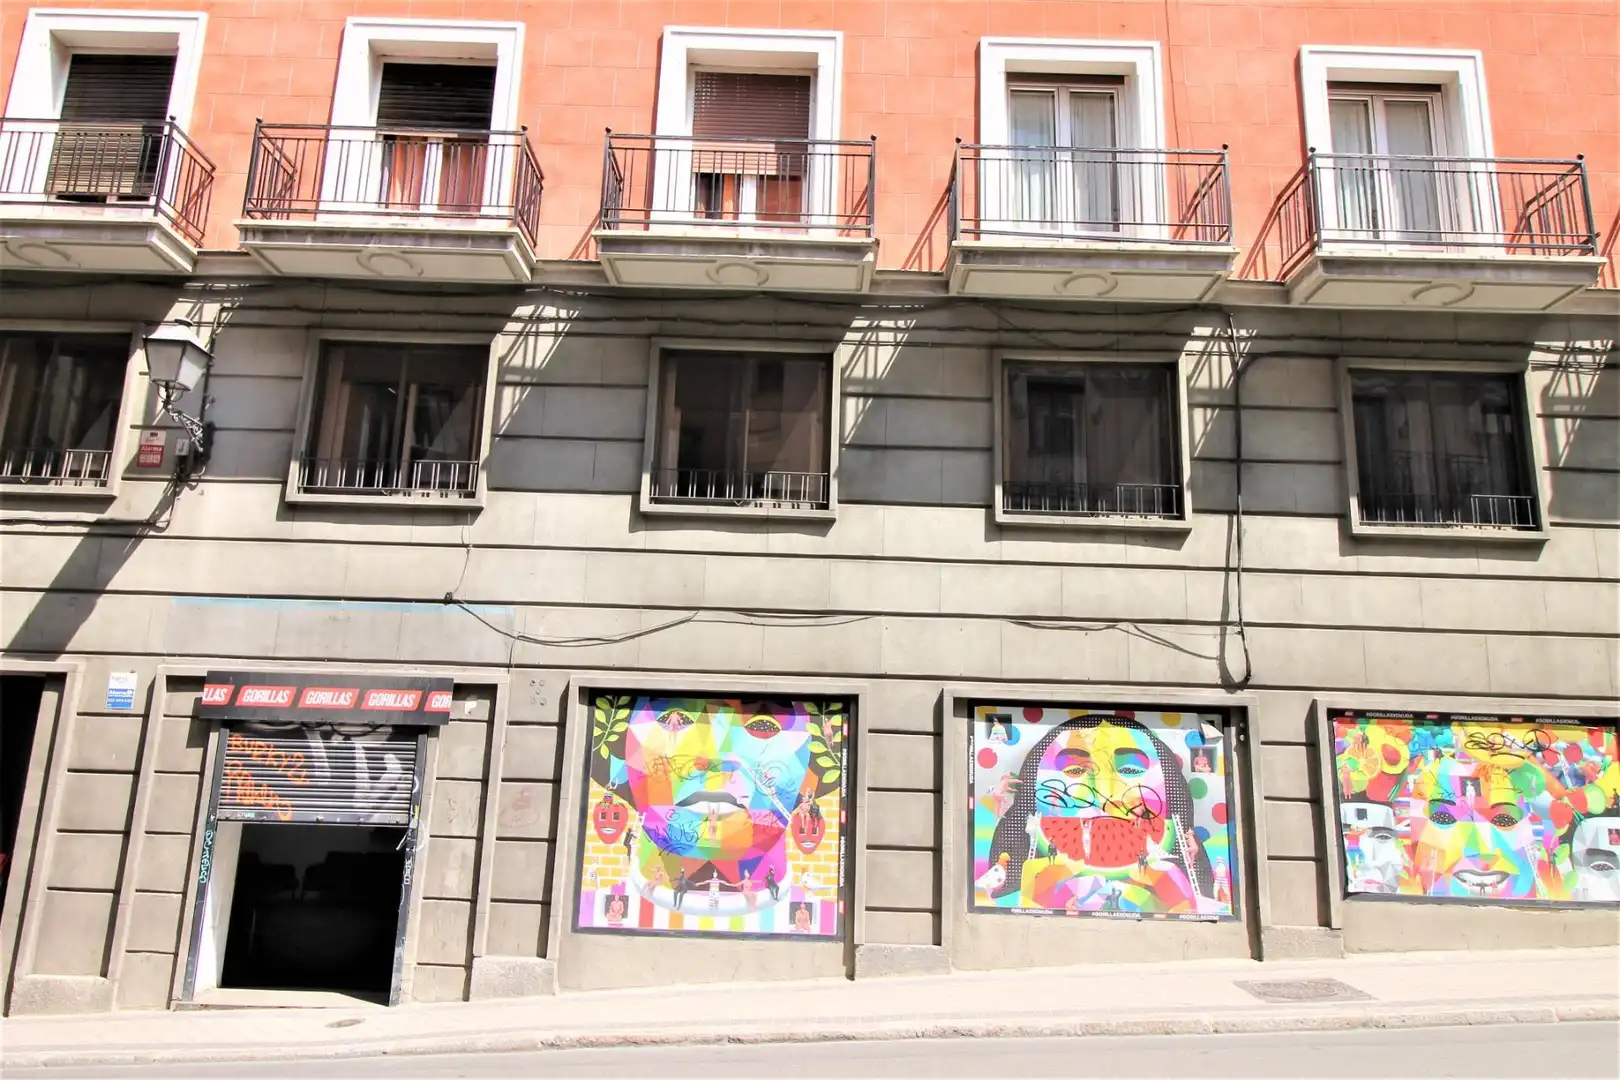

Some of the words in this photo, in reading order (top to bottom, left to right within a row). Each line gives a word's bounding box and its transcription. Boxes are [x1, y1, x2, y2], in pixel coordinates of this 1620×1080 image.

[242, 688, 290, 704] GORILLAS
[305, 690, 353, 706] GORILLAS
[367, 692, 416, 708] GORILLAS
